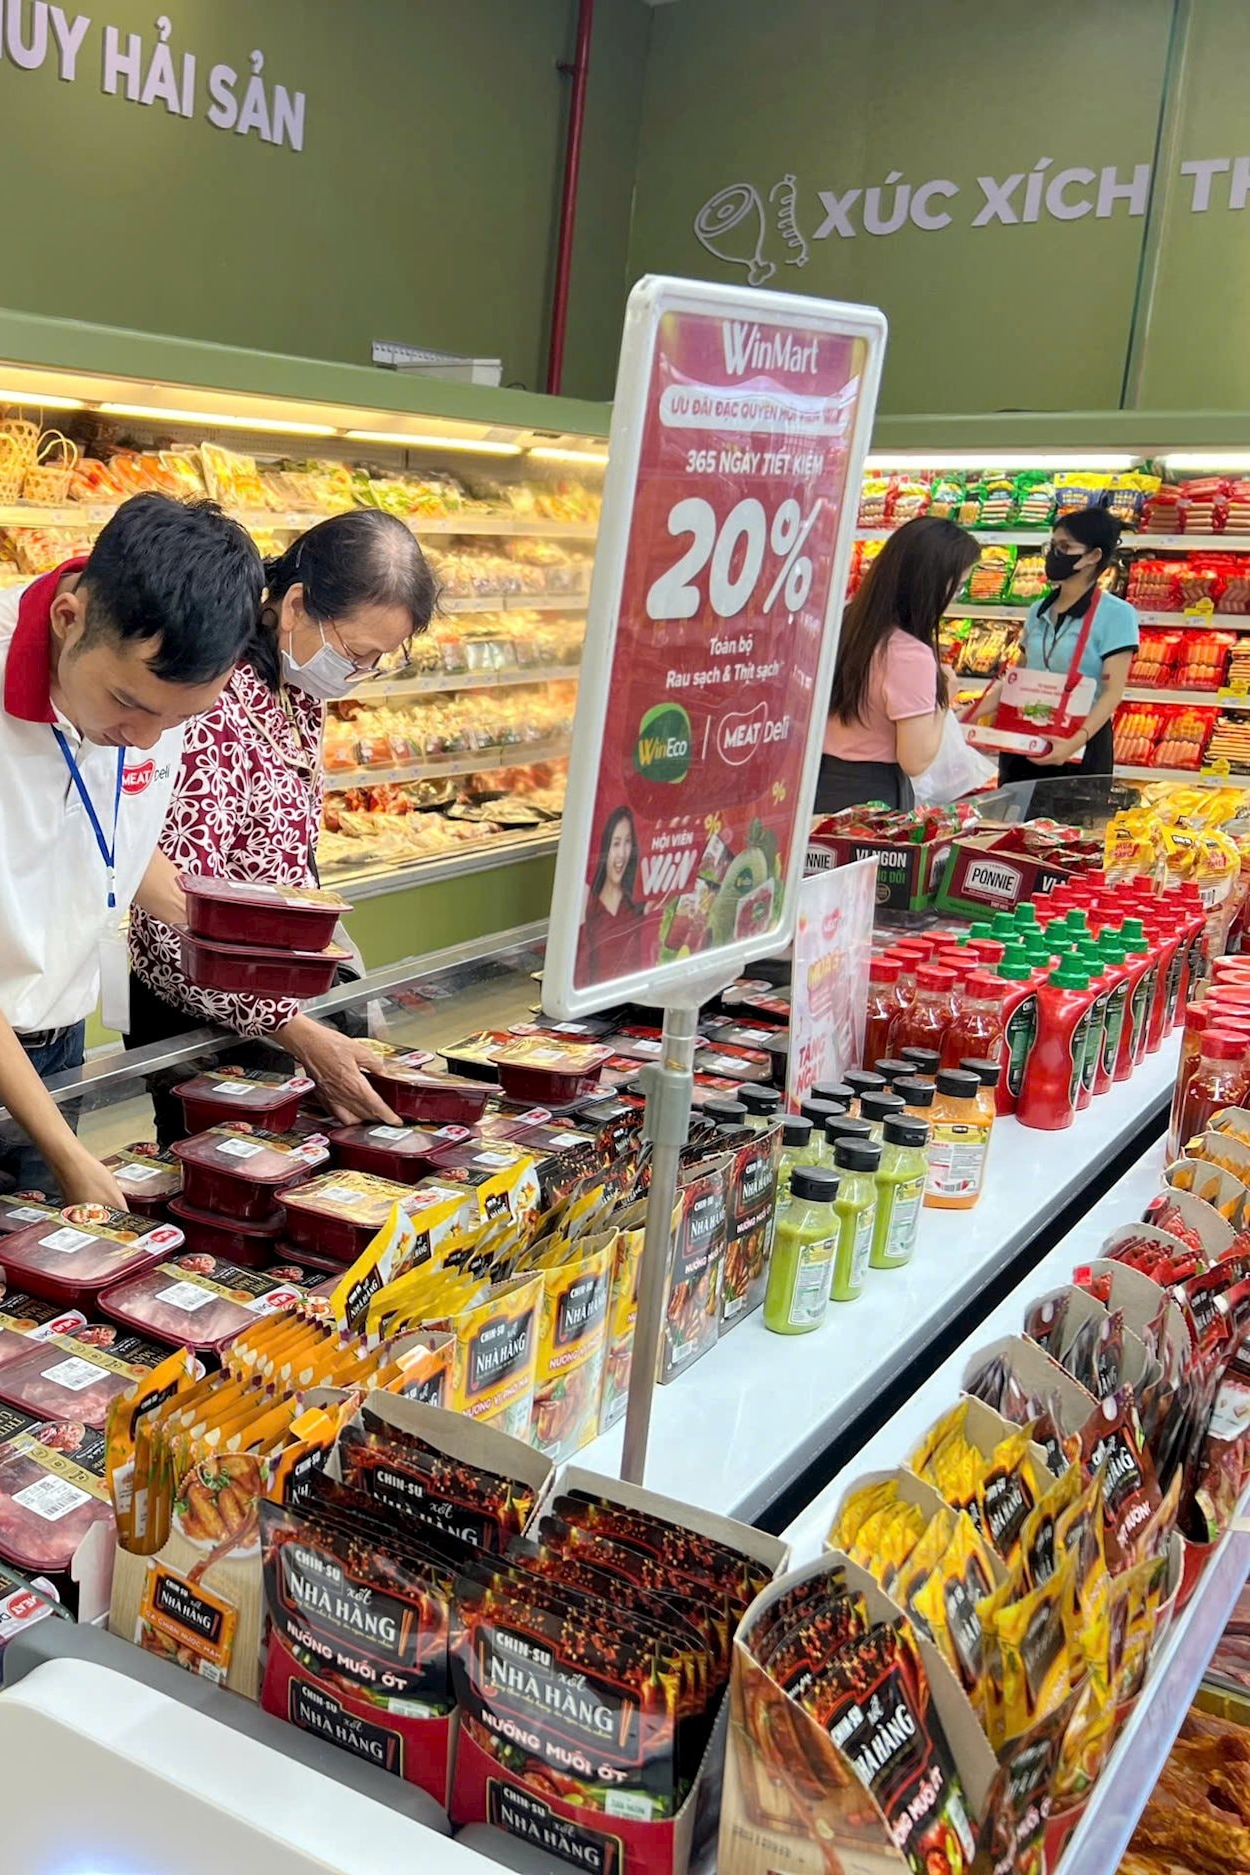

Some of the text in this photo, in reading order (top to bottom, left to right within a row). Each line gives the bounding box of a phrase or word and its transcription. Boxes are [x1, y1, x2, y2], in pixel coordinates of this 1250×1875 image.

[102, 16, 197, 118] HẢI
[207, 49, 306, 151] SẢN
[812, 170, 960, 240] XÚC
[971, 156, 1150, 229] XÍCH
[721, 319, 819, 376] WinMart
[685, 449, 717, 473] 365
[646, 497, 827, 620] 20%
[666, 670, 690, 689] Rau
[693, 666, 721, 686] sạch
[722, 665, 730, 682] &
[638, 737, 687, 766] WinEco
[723, 715, 790, 749] MEAT Deli
[122, 771, 150, 787] MEAT
[806, 853, 831, 869] NNIE
[476, 1332, 526, 1373] NHÀ HÀNG
[376, 1470, 423, 1499] CHIN-SU
[294, 1549, 341, 1582] CHIN-SU
[161, 1590, 211, 1629] NHÀ HÀNG
[290, 1572, 396, 1643] NHÀ HÀNG
[287, 1620, 408, 1691] NƯỚNG MUỐI ỚT
[496, 1632, 551, 1667] CHIN-SU
[301, 1686, 338, 1713] CHIN-SU
[491, 1655, 614, 1732] NHÀ HÀNG
[557, 1673, 587, 1692] xốt
[300, 1701, 383, 1760] NHÀ HÀNG
[482, 1709, 541, 1749] NƯỚNG
[546, 1741, 593, 1776] MUỐI
[872, 1703, 916, 1763] HÀNG
[503, 1787, 546, 1818] CHIN-SU
[501, 1804, 600, 1867] NHÀ HÀNG
